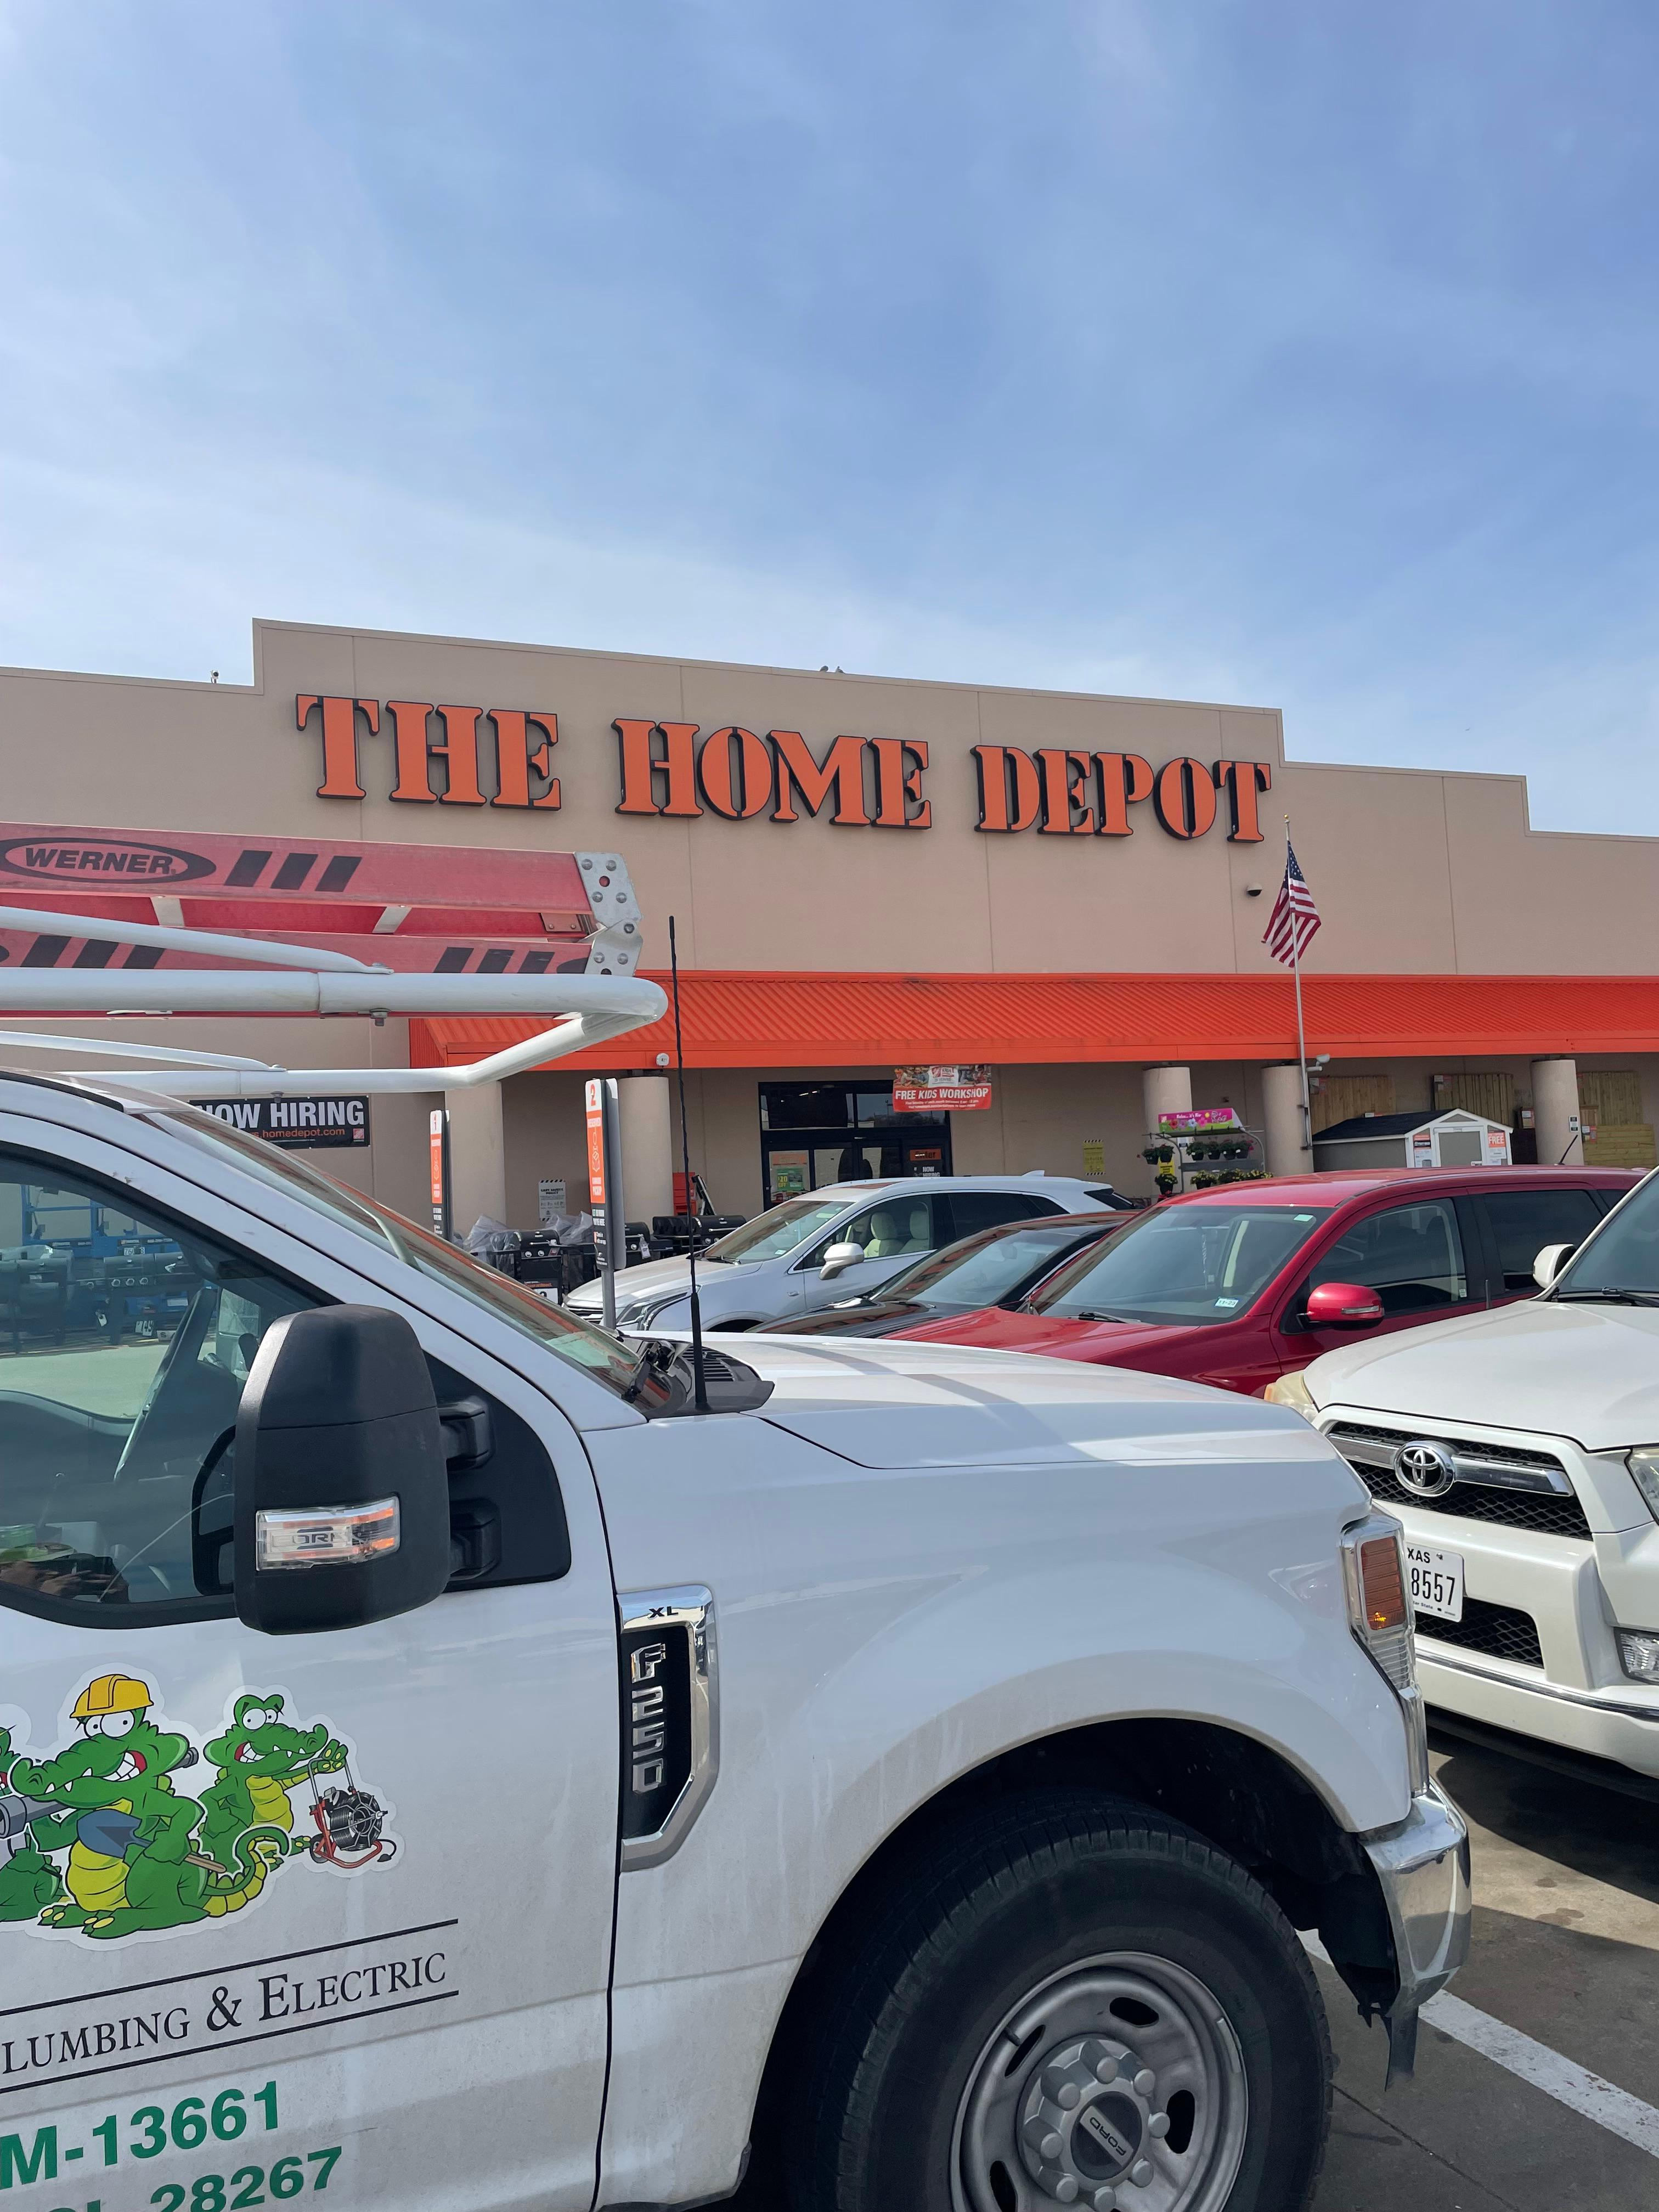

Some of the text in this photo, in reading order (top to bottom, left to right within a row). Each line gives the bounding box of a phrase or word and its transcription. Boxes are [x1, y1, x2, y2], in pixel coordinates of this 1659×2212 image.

[296, 694, 1271, 843] THE HOME DEPOT
[26, 848, 173, 874] WERNER
[591, 1084, 596, 1106] 2
[895, 1088, 989, 1099] FREE KIDS WORKSHOP
[270, 1101, 364, 1127] HIRING
[1488, 1136, 1505, 1145] FREE
[1411, 1567, 1455, 1605] 8557
[648, 1605, 679, 1619] XL
[2, 1953, 446, 2075] LUMBING & ELECTRIC
[0, 2081, 278, 2190] M-13661
[1090, 2117, 1126, 2156] FORD
[150, 2146, 342, 2212] 28267
